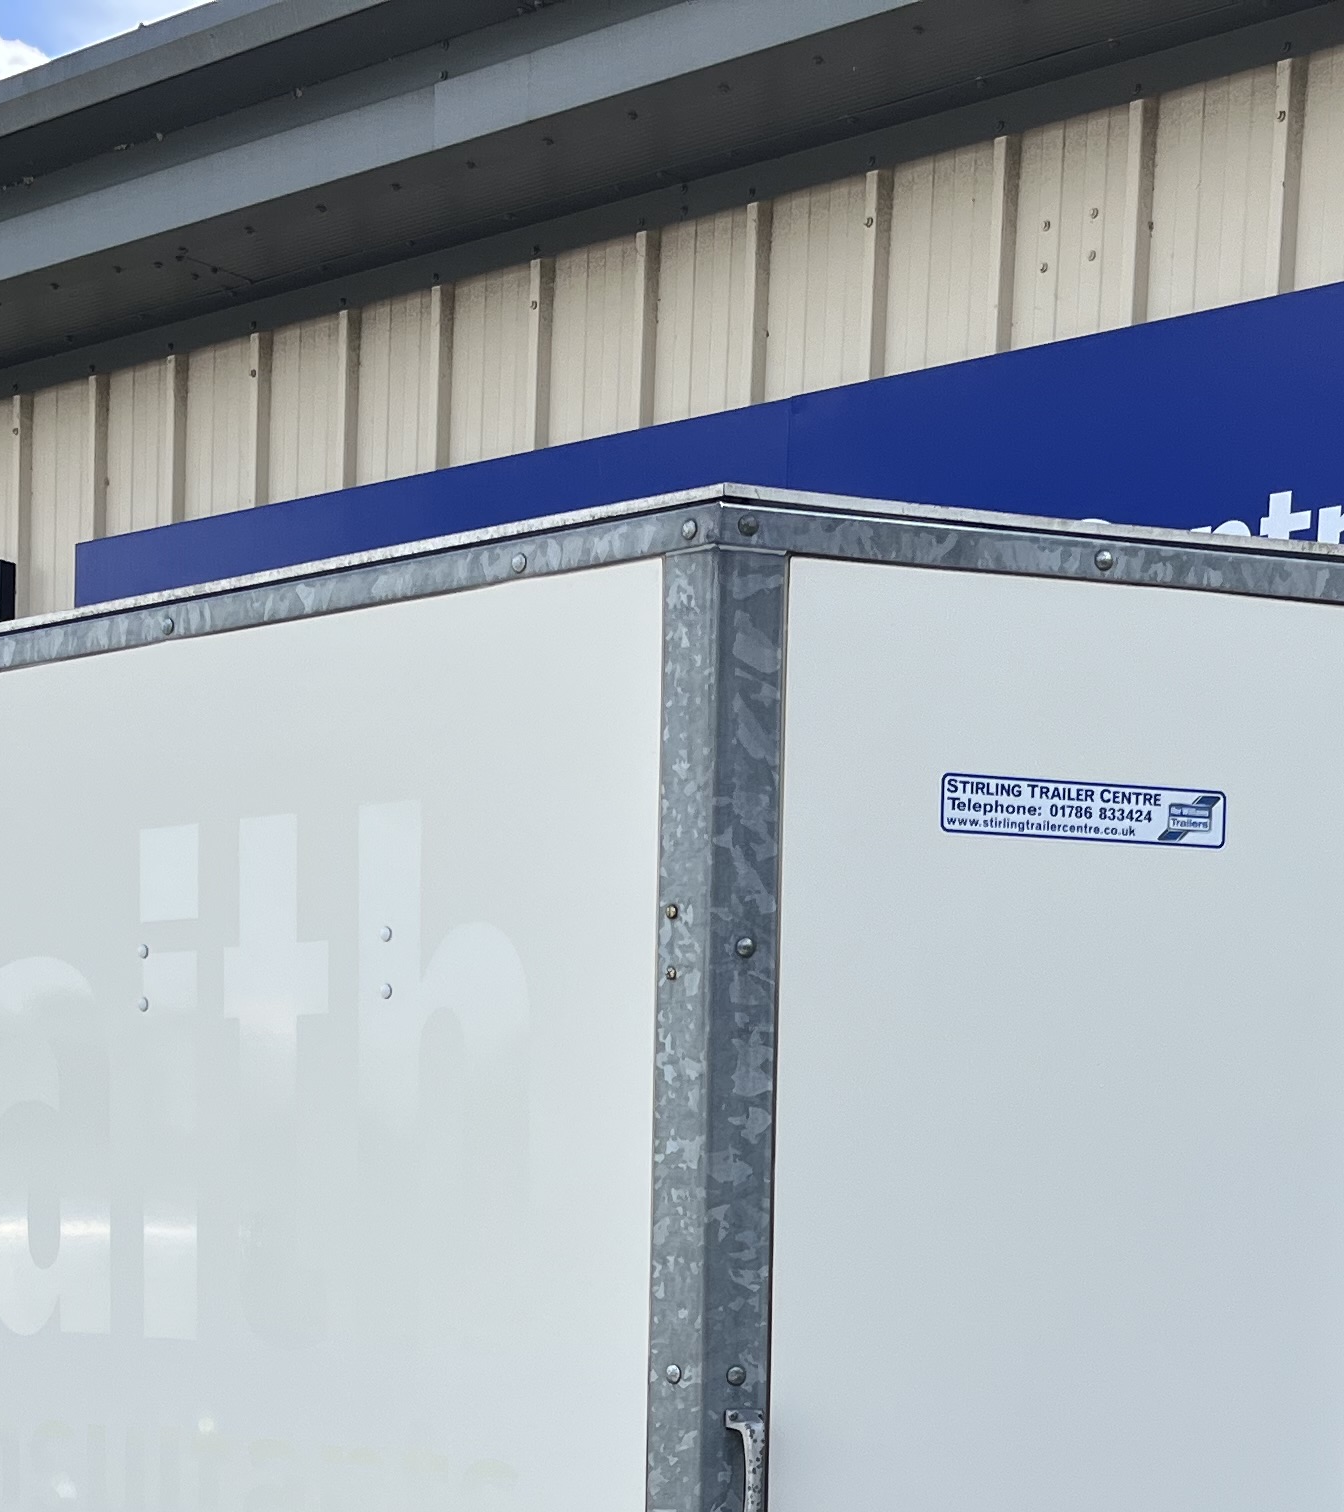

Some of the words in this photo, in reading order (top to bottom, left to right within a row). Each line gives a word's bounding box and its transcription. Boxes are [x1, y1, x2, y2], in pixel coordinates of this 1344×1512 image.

[946, 777, 1023, 799] STIRLING
[1026, 783, 1095, 803] TRAILER
[1099, 788, 1162, 808] CENTRE
[948, 797, 1043, 819] Telephone:
[1049, 804, 1093, 821] 01786
[1098, 806, 1153, 824] 833424
[946, 816, 1136, 837] www.stirlingtrailercentre.co.uk
